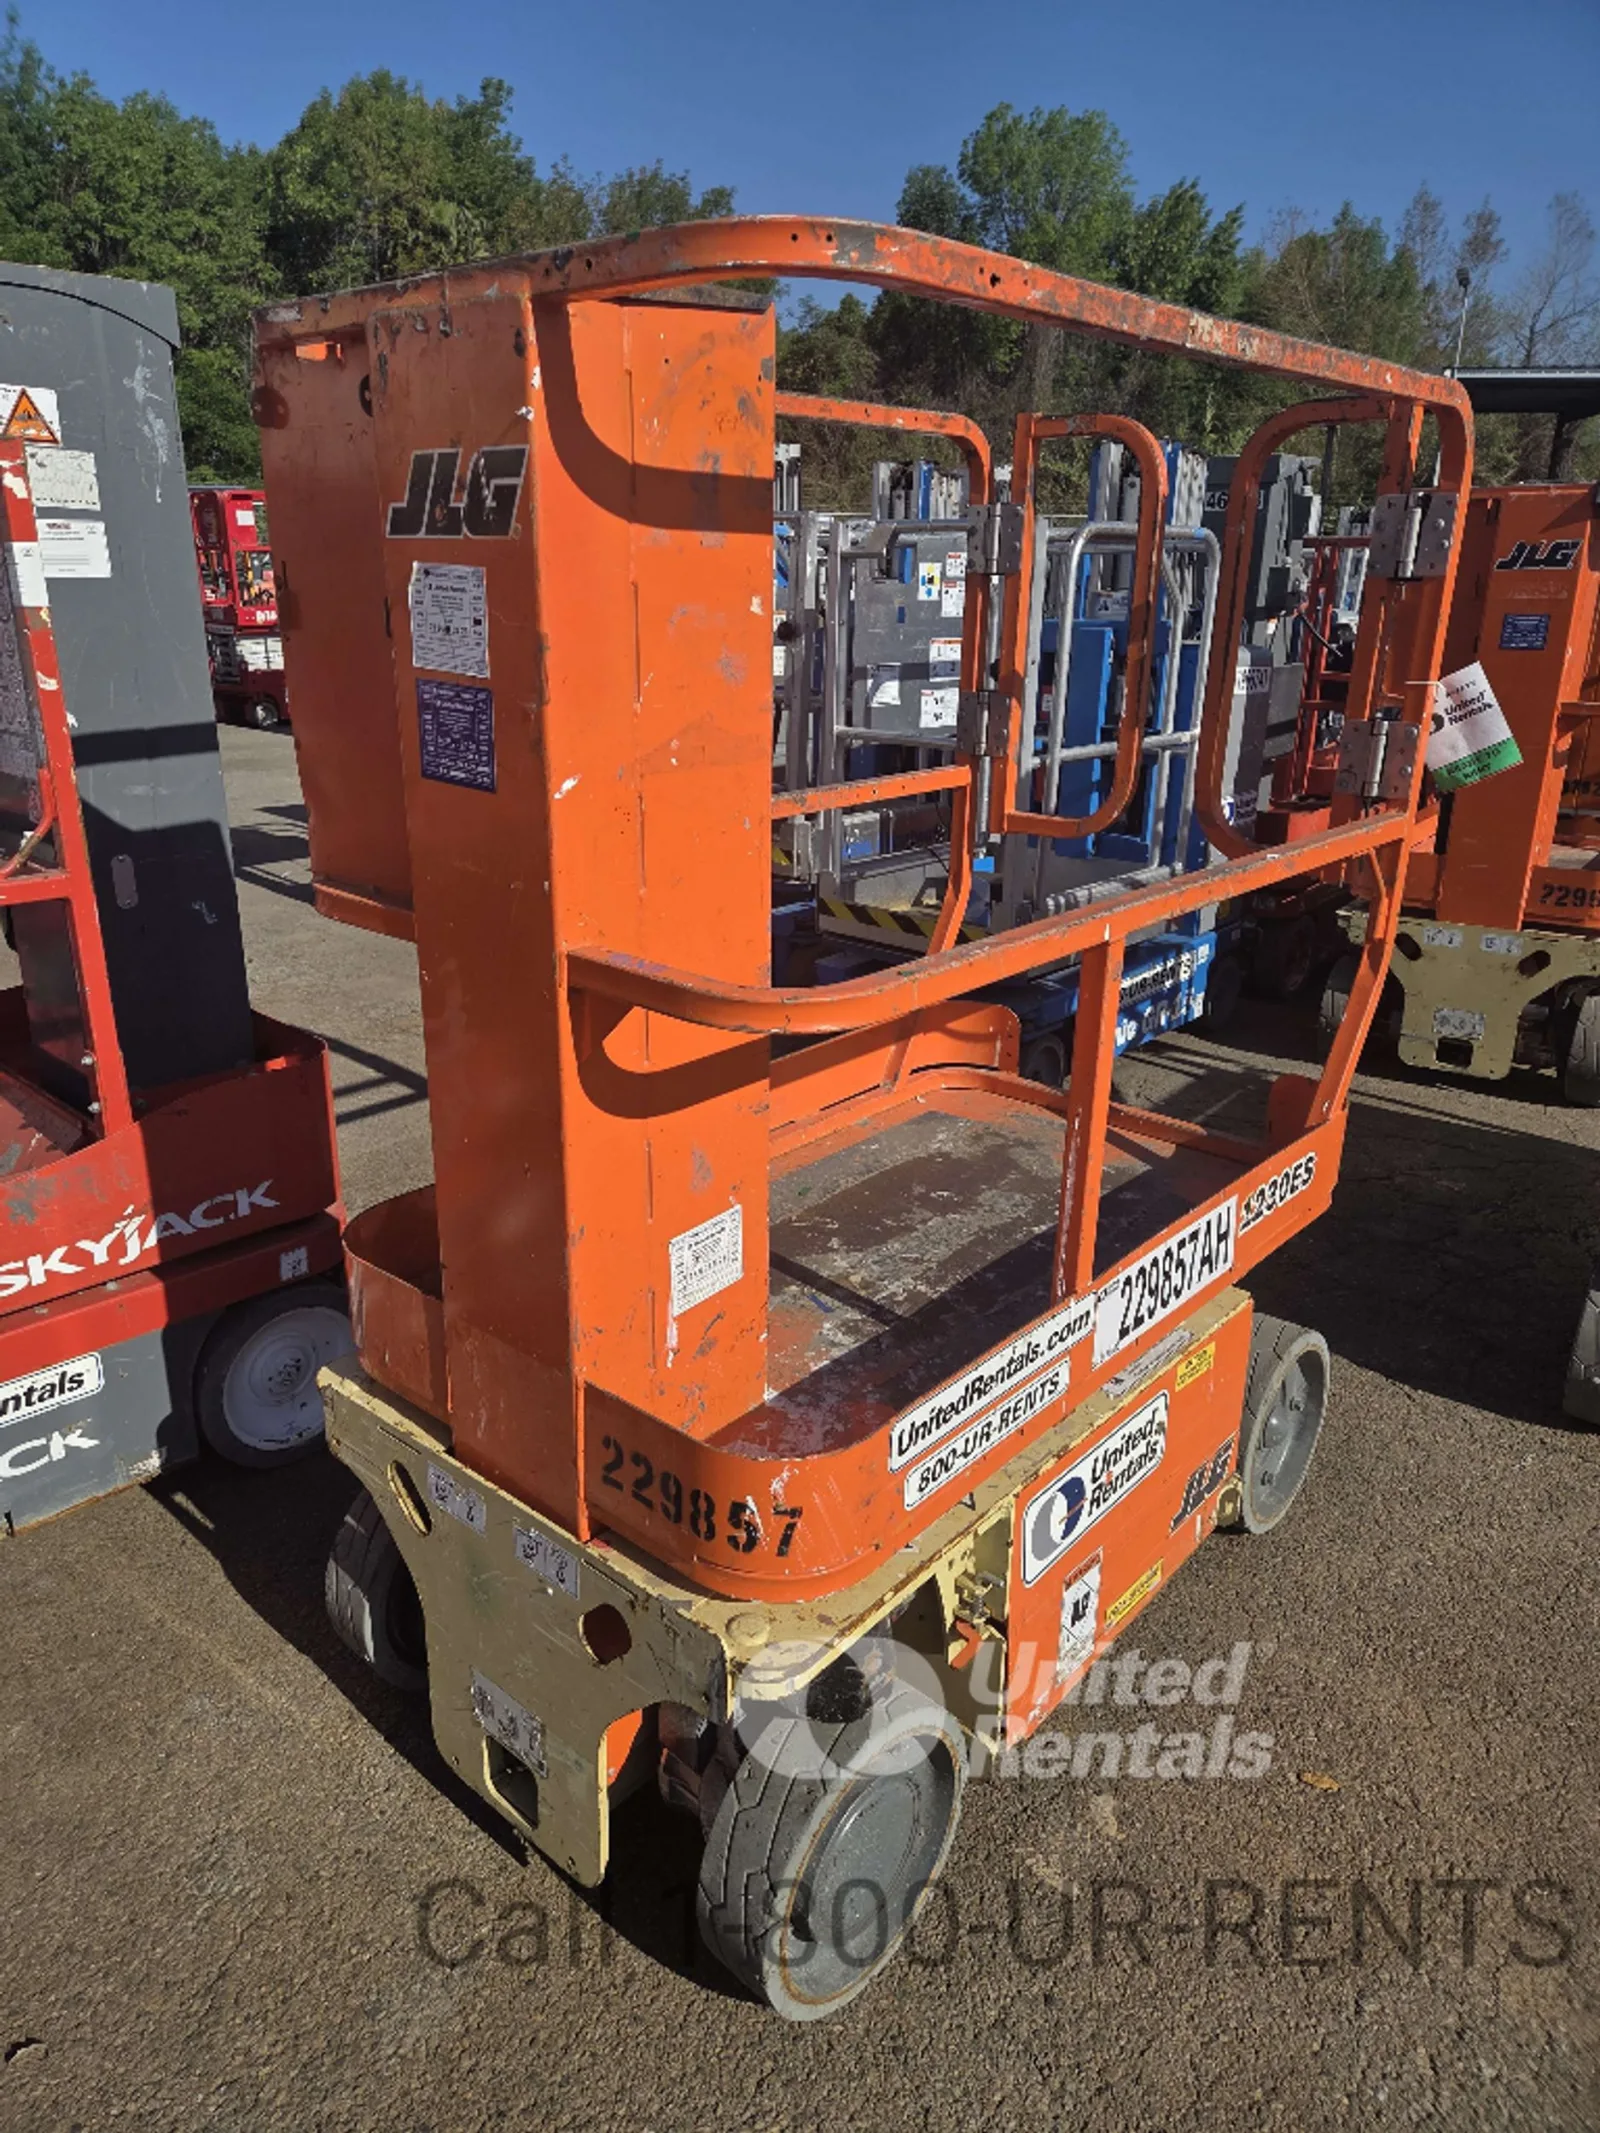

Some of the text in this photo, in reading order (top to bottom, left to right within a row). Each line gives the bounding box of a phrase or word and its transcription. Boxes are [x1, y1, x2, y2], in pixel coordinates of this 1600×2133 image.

[386, 444, 529, 539] JLG
[1493, 539, 1583, 571] JLG
[1118, 1206, 1231, 1340] 229857AH
[0, 1371, 84, 1417] ntals
[898, 1310, 1090, 1456] UnitedRentals.com
[0, 1429, 100, 1479] CK
[917, 1371, 1060, 1492] 800-UR-RENTS
[1092, 1408, 1159, 1484] United
[601, 1435, 803, 1557] 229857
[1088, 1439, 1158, 1517] Rentals
